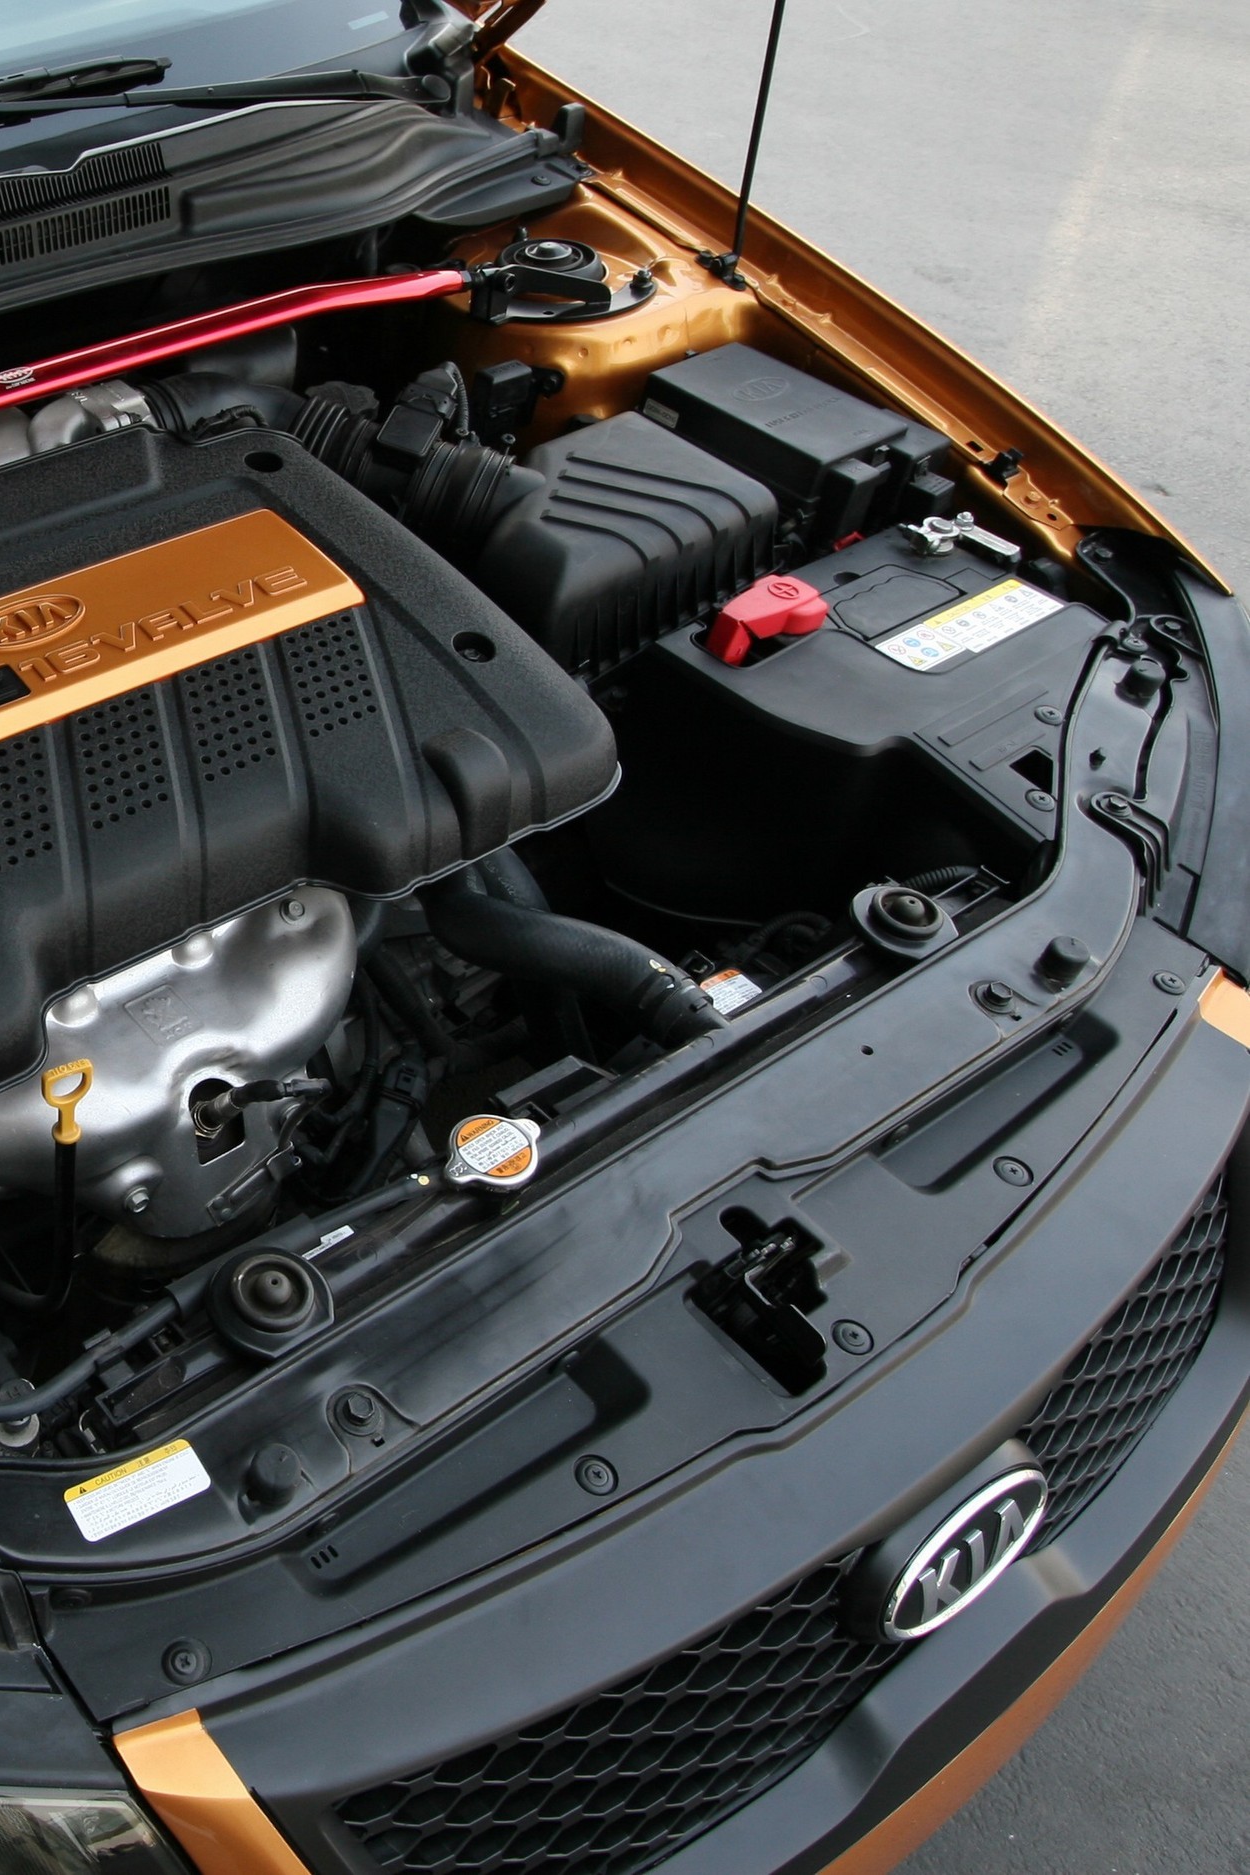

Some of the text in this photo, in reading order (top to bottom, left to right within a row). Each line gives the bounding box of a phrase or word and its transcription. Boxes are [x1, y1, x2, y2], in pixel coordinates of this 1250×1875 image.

[468, 1119, 494, 1138] WARNING
[94, 1466, 128, 1487] CAUTION
[916, 1497, 1026, 1624] KIA
